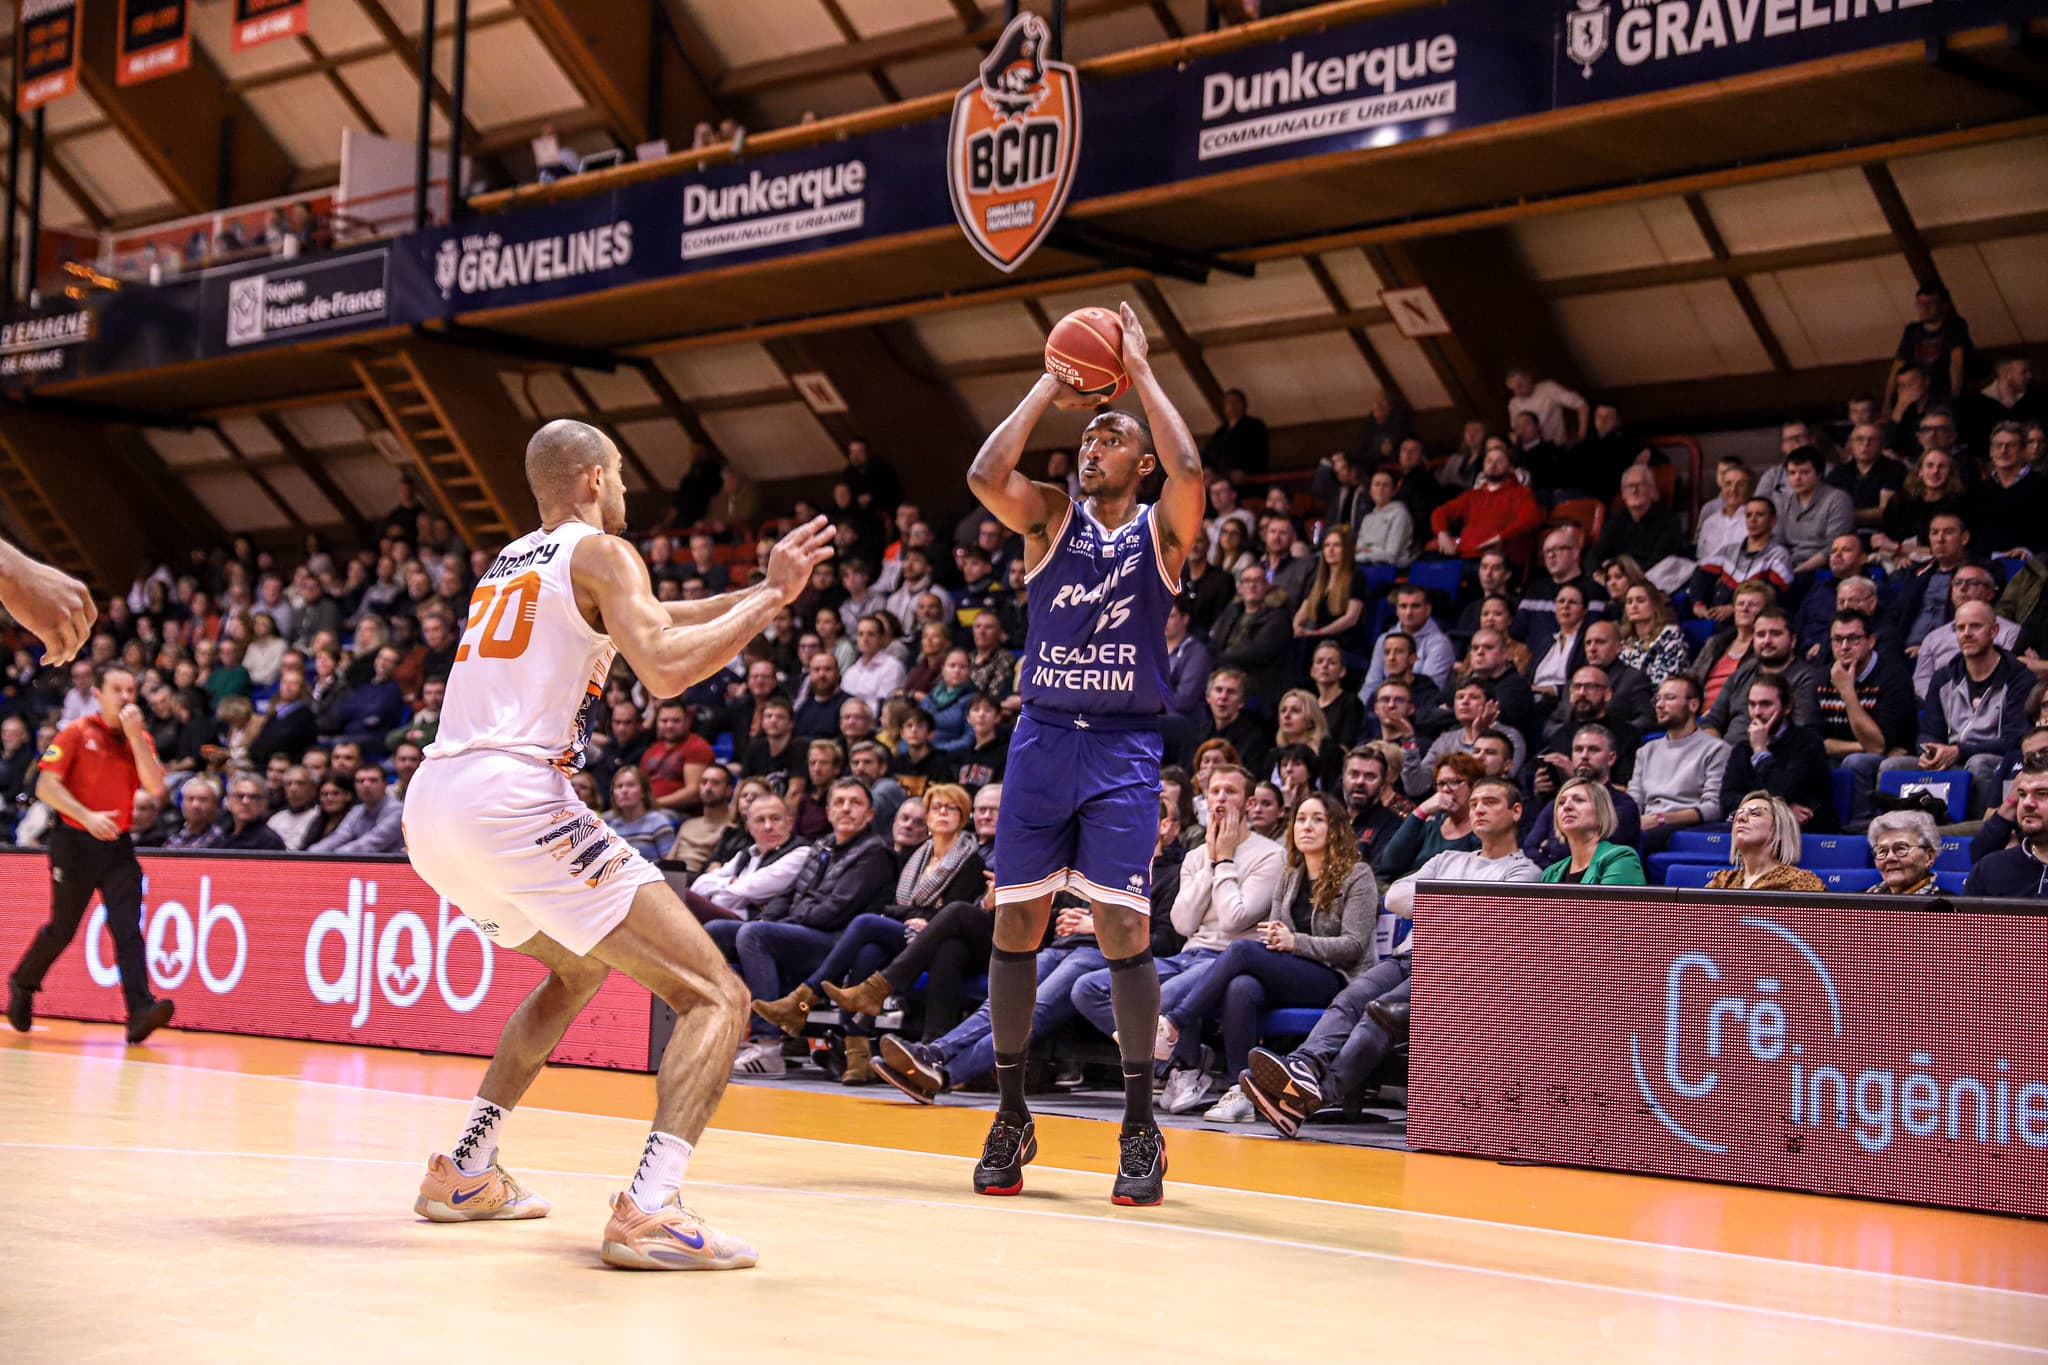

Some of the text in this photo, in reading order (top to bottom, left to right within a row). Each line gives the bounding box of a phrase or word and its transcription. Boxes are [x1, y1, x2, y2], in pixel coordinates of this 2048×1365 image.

[1202, 34, 1458, 121] Dunkerque
[1357, 90, 1450, 121] URBAINE
[970, 119, 1060, 191] BCM
[684, 160, 866, 226] Dunkerque
[795, 208, 858, 232] URBAINE
[459, 220, 632, 294] GRAVELINES
[455, 571, 541, 660] 20
[1031, 665, 1135, 692] INTERIM
[1039, 640, 1137, 666] LEADER
[304, 876, 495, 1029] djob
